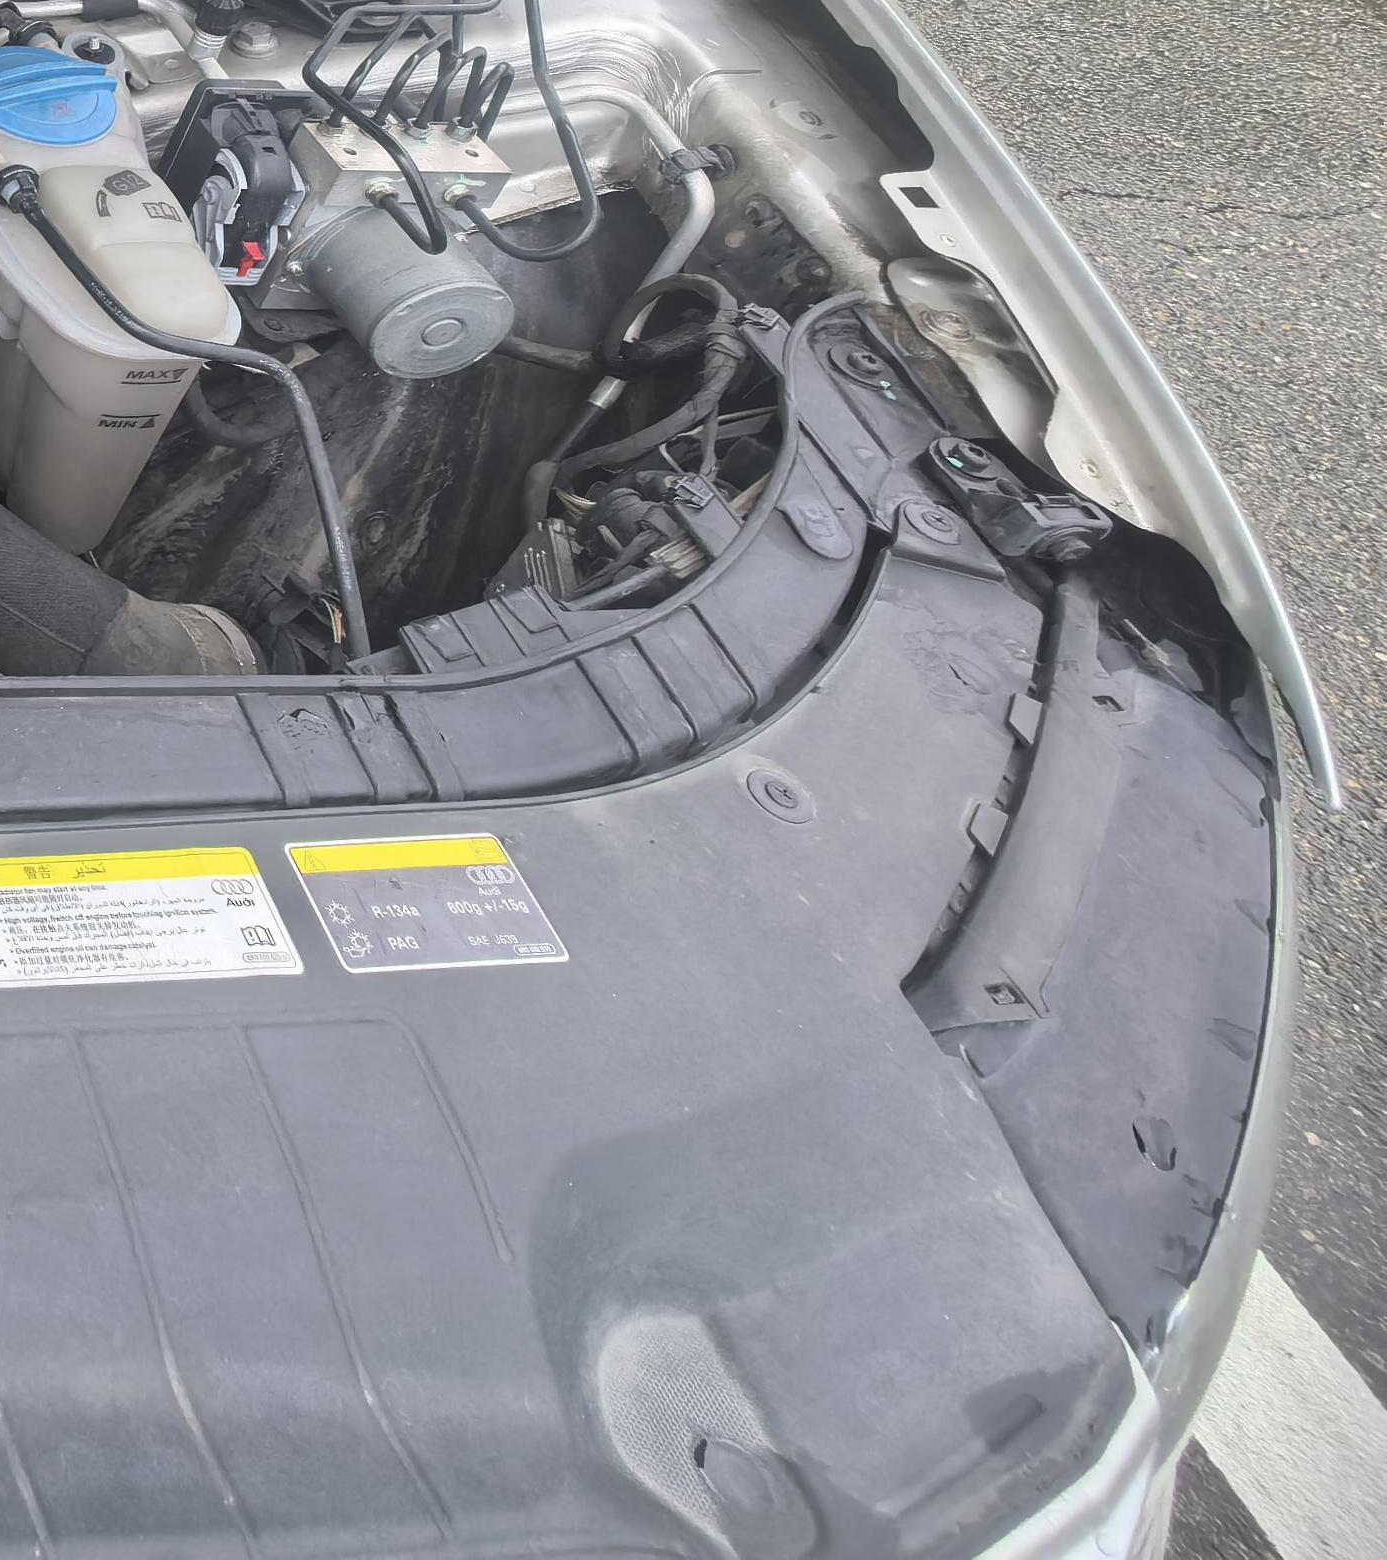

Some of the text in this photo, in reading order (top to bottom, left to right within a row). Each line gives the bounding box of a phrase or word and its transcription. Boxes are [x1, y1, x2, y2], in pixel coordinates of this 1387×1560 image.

[112, 174, 144, 191] G12
[126, 370, 168, 380] MAX
[98, 419, 138, 429] MIN
[23, 864, 51, 880] 警告
[478, 884, 502, 897] Audi
[226, 897, 256, 908] Audi
[371, 903, 422, 920] R-134a
[447, 901, 482, 917] 600g
[387, 933, 518, 951] PAG SAE J639
